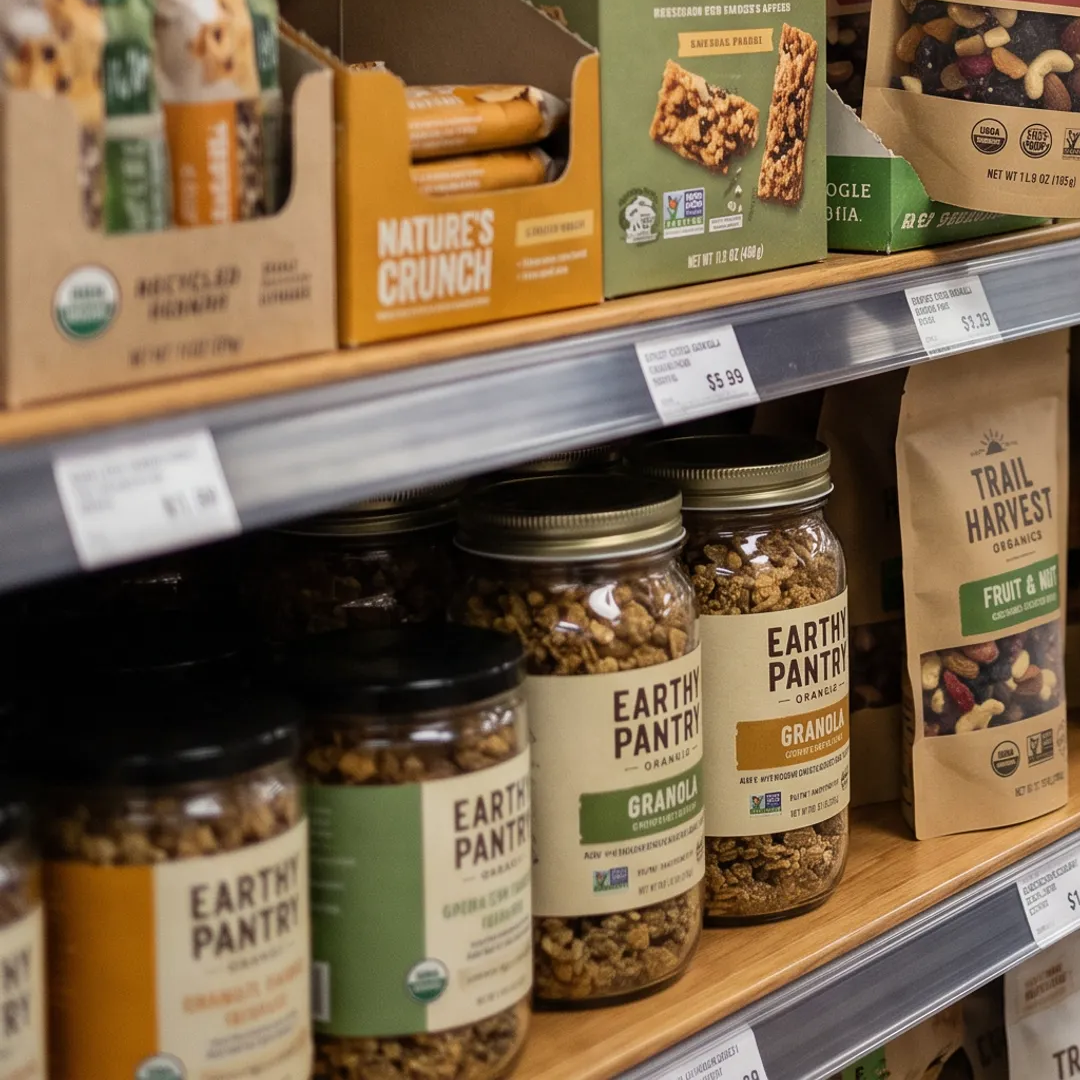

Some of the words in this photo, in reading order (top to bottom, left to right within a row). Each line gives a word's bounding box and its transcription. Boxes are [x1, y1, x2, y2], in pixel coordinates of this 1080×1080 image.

[987, 168, 1003, 180] NET
[1005, 170, 1018, 181] WT
[1039, 174, 1050, 185] OZ
[377, 208, 495, 258] NATURE'S
[378, 248, 493, 307] CRUNCH
[688, 254, 701, 268] NET
[702, 252, 714, 266] WT
[970, 456, 1034, 501] TRAIL
[965, 486, 1053, 544] HARVEST
[983, 577, 1022, 609] FRUIT
[1026, 573, 1037, 595] &
[767, 606, 847, 658] EARTHY
[769, 640, 848, 692] PANTRY
[614, 666, 700, 723] EARTHY
[614, 702, 700, 759] PANTRY
[781, 707, 845, 748] GRANOLA
[454, 775, 529, 833] EARTH
[628, 774, 698, 819] GRANOLA
[455, 811, 530, 869] PANTR
[189, 855, 301, 920] EARTHY
[191, 894, 300, 960] PANTRY
